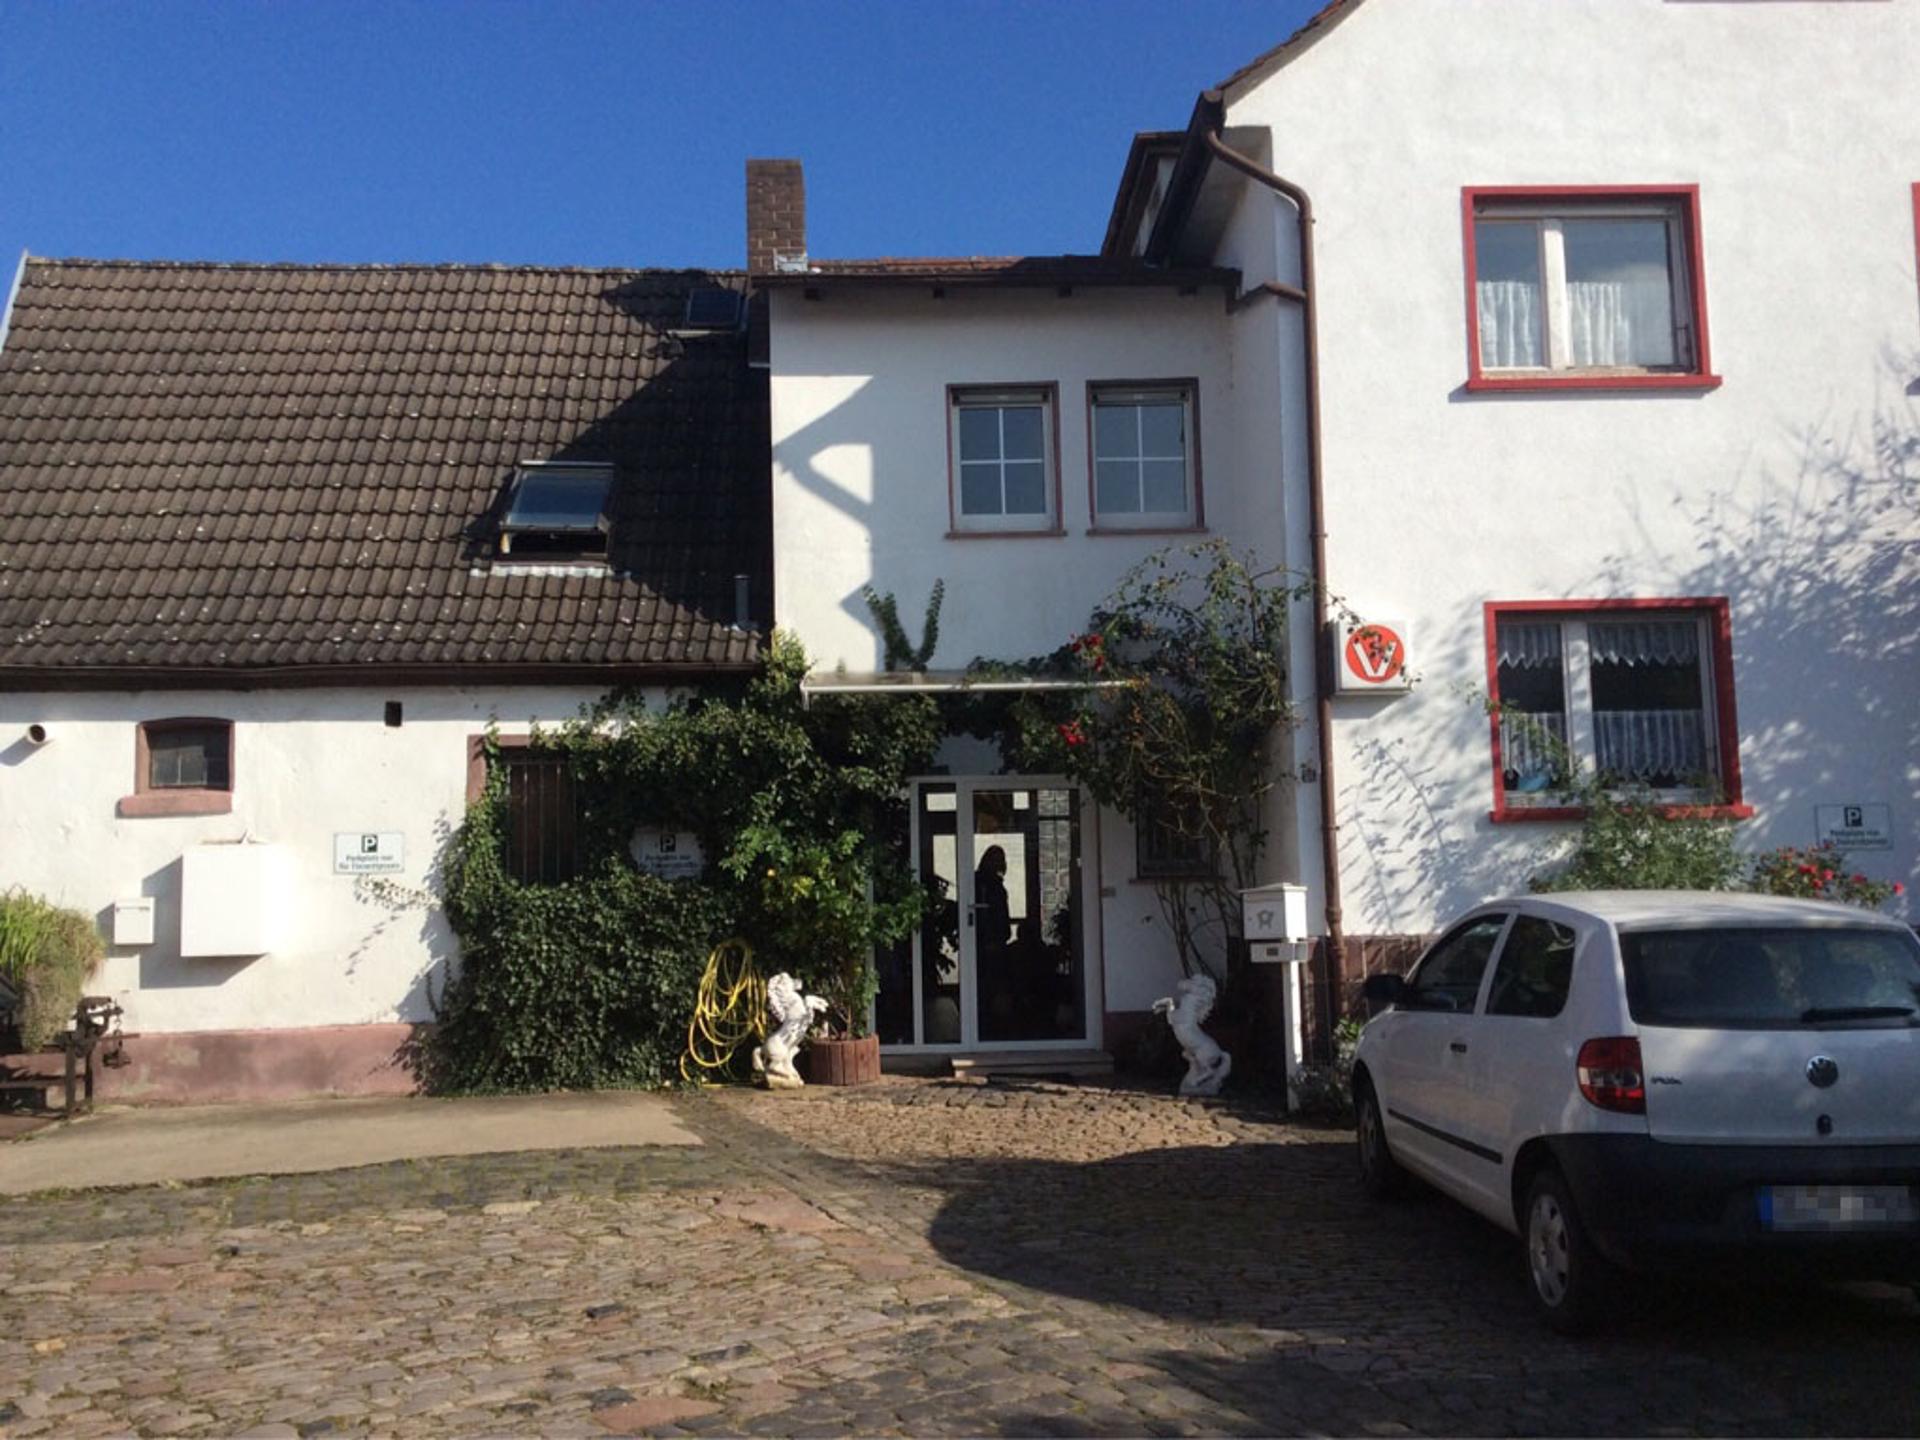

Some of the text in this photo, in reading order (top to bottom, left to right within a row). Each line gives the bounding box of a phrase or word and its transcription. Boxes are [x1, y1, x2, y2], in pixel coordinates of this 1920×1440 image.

[1846, 808, 1861, 826] P
[363, 835, 377, 852] P
[662, 835, 675, 852] P
